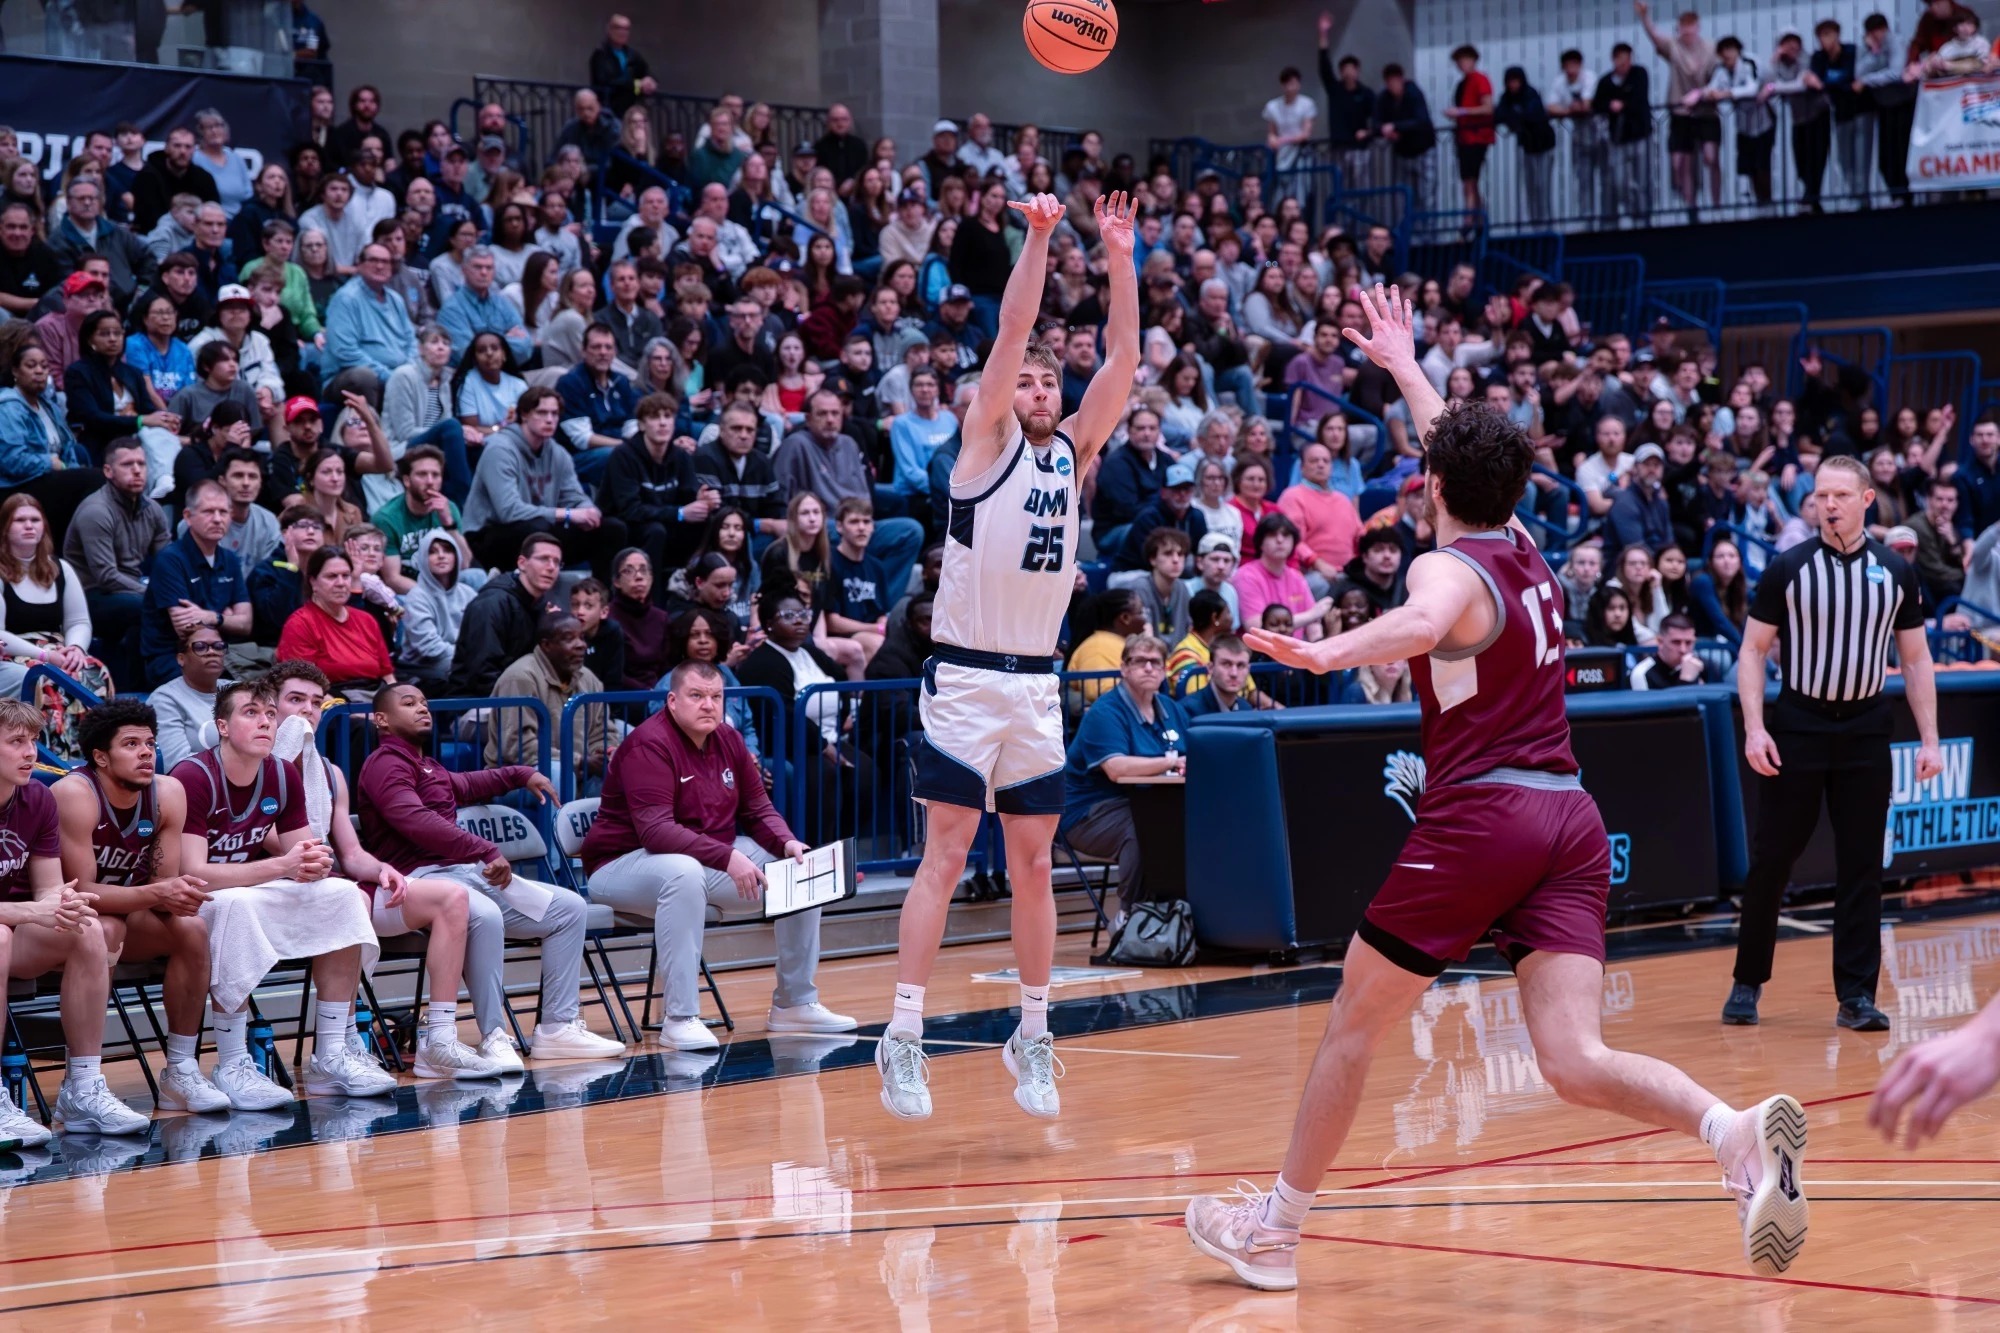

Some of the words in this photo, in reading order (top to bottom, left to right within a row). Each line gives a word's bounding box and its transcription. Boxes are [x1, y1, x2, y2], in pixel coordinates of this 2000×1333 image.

[1052, 8, 1108, 46] Wilson
[1020, 523, 1065, 574] 25
[1577, 668, 1605, 683] POSS.
[1893, 802, 2000, 849] ATHLETIC
